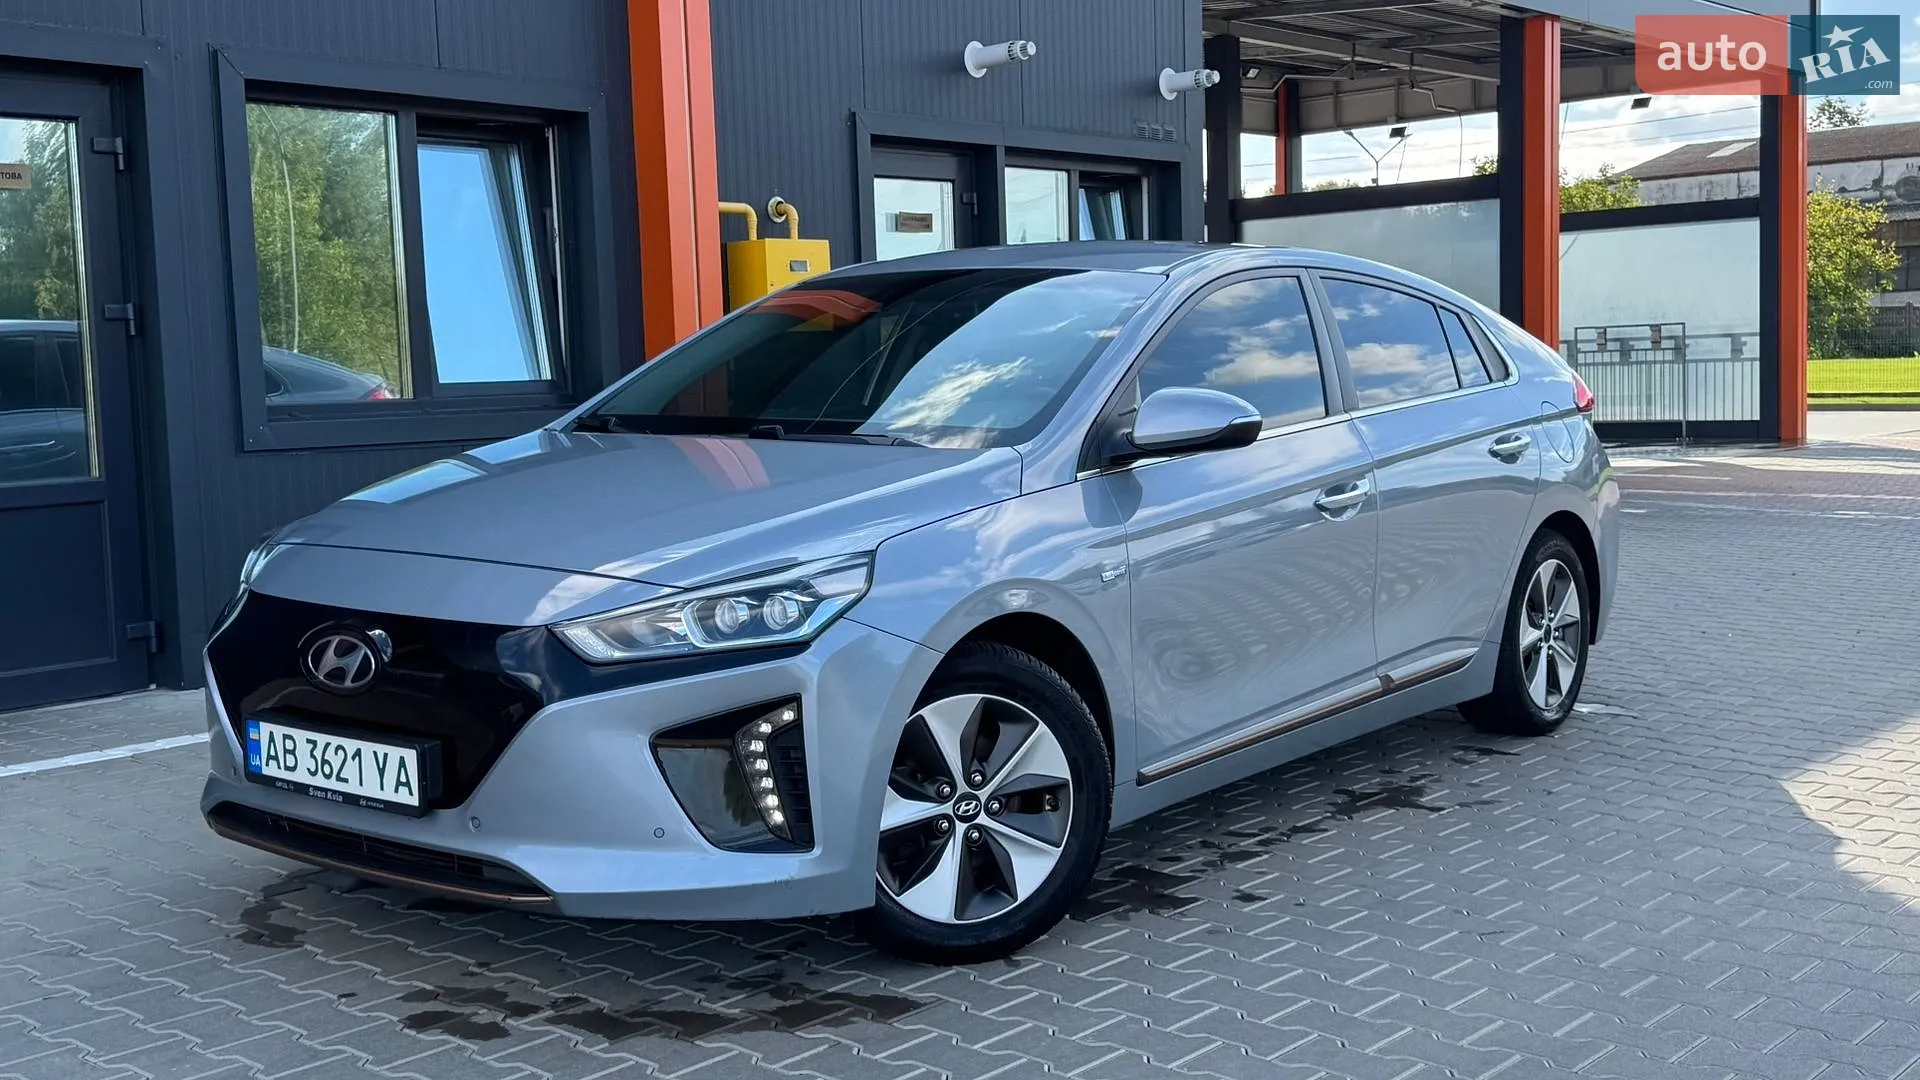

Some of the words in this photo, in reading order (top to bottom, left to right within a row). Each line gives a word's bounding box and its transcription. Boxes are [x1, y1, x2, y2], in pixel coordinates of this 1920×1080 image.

[250, 756, 261, 767] UA
[265, 730, 299, 773] AB
[305, 737, 364, 787] 3621
[372, 750, 414, 797] YA
[308, 787, 326, 798] Sven
